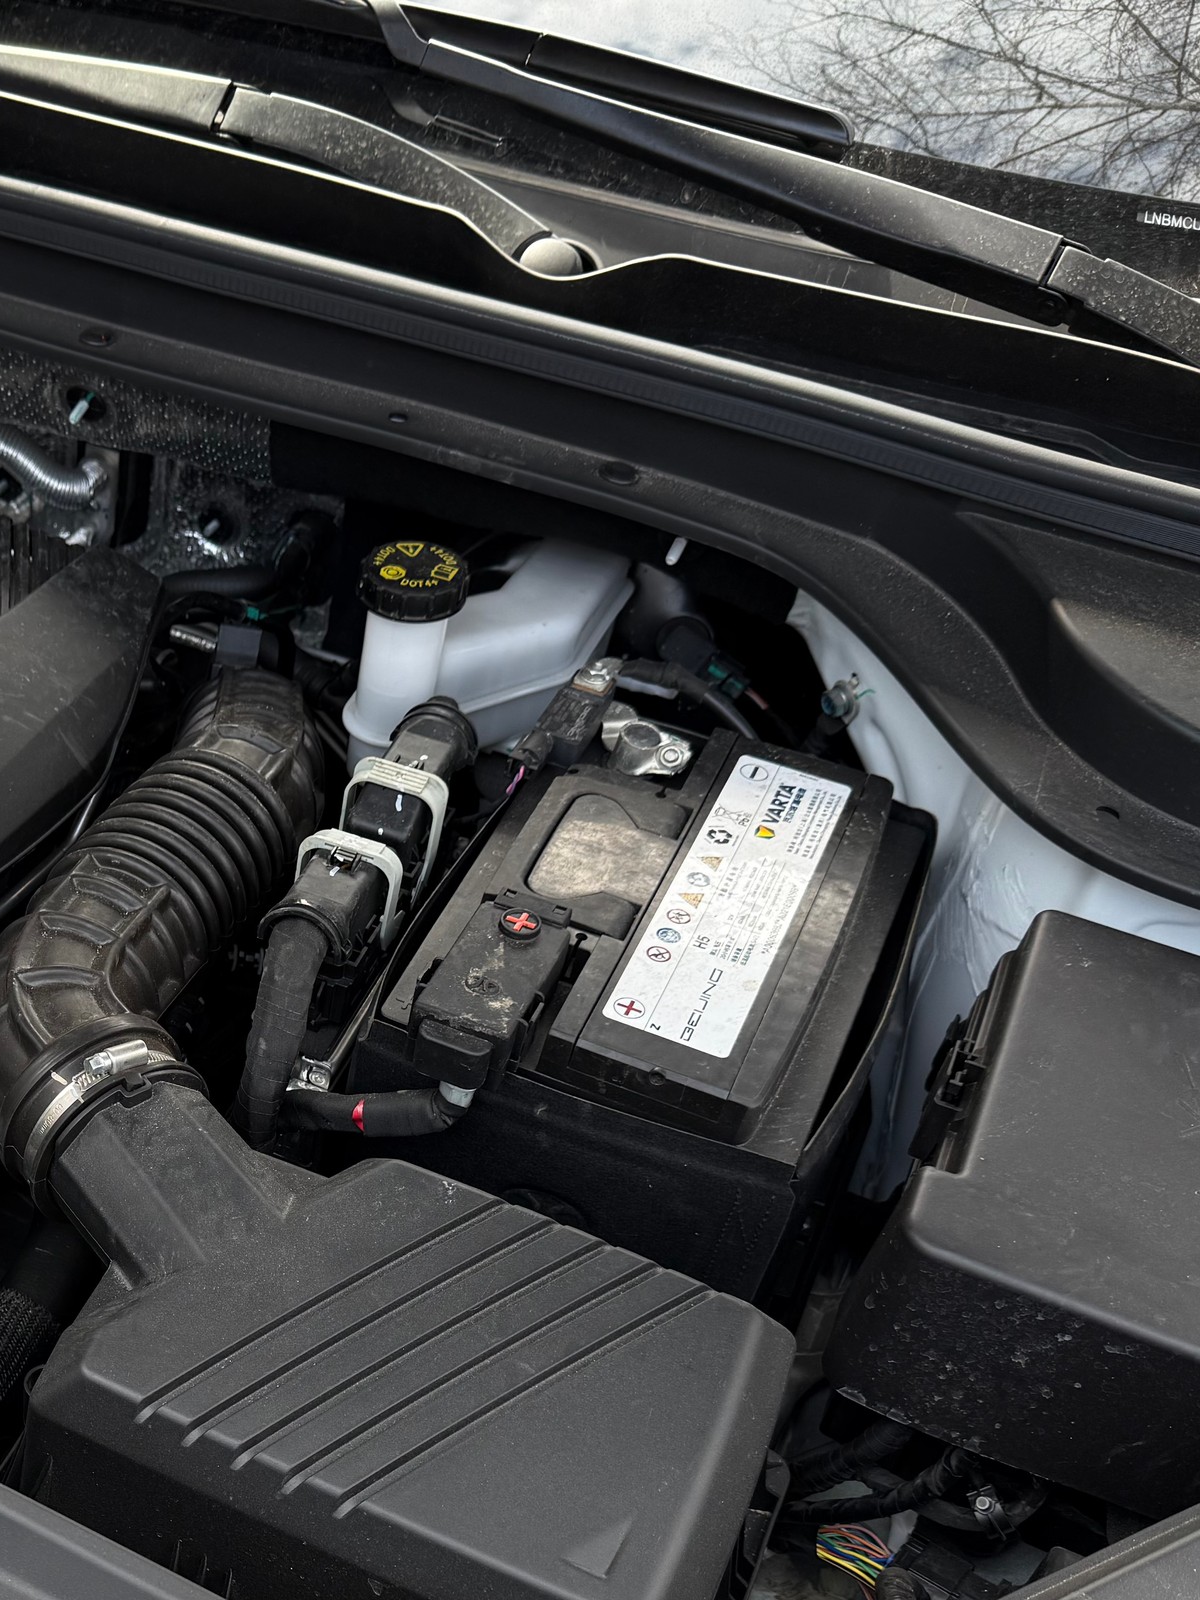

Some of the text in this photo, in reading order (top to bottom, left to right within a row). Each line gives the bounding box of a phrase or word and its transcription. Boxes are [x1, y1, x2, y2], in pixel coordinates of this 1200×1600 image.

[761, 783, 796, 825] VARTA
[693, 934, 711, 950] H5
[680, 967, 723, 1042] BEIJING
